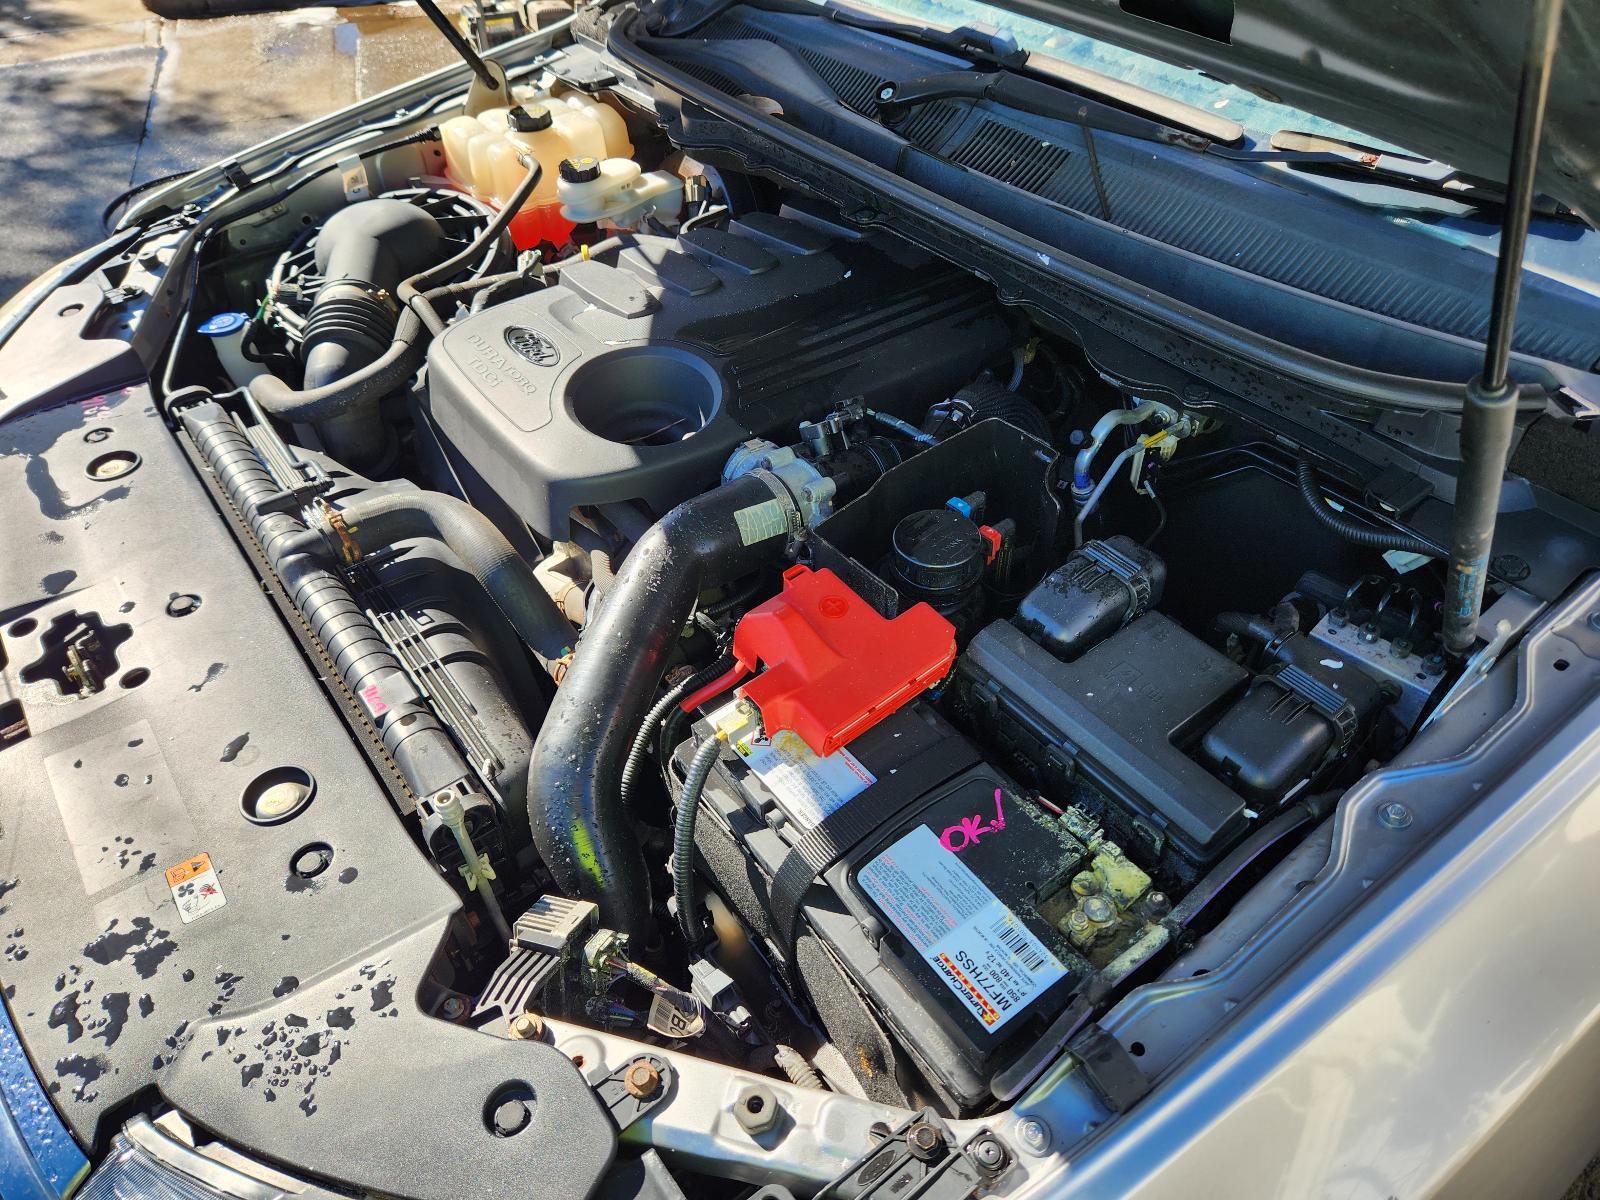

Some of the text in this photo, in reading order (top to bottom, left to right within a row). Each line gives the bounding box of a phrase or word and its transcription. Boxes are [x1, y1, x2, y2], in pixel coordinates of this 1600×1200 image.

[986, 953, 996, 963] 12
[955, 950, 1013, 1011] MF77HSS
[989, 969, 1003, 983] 800
[1000, 968, 1013, 981] 140
[1006, 988, 1021, 1003] 850
